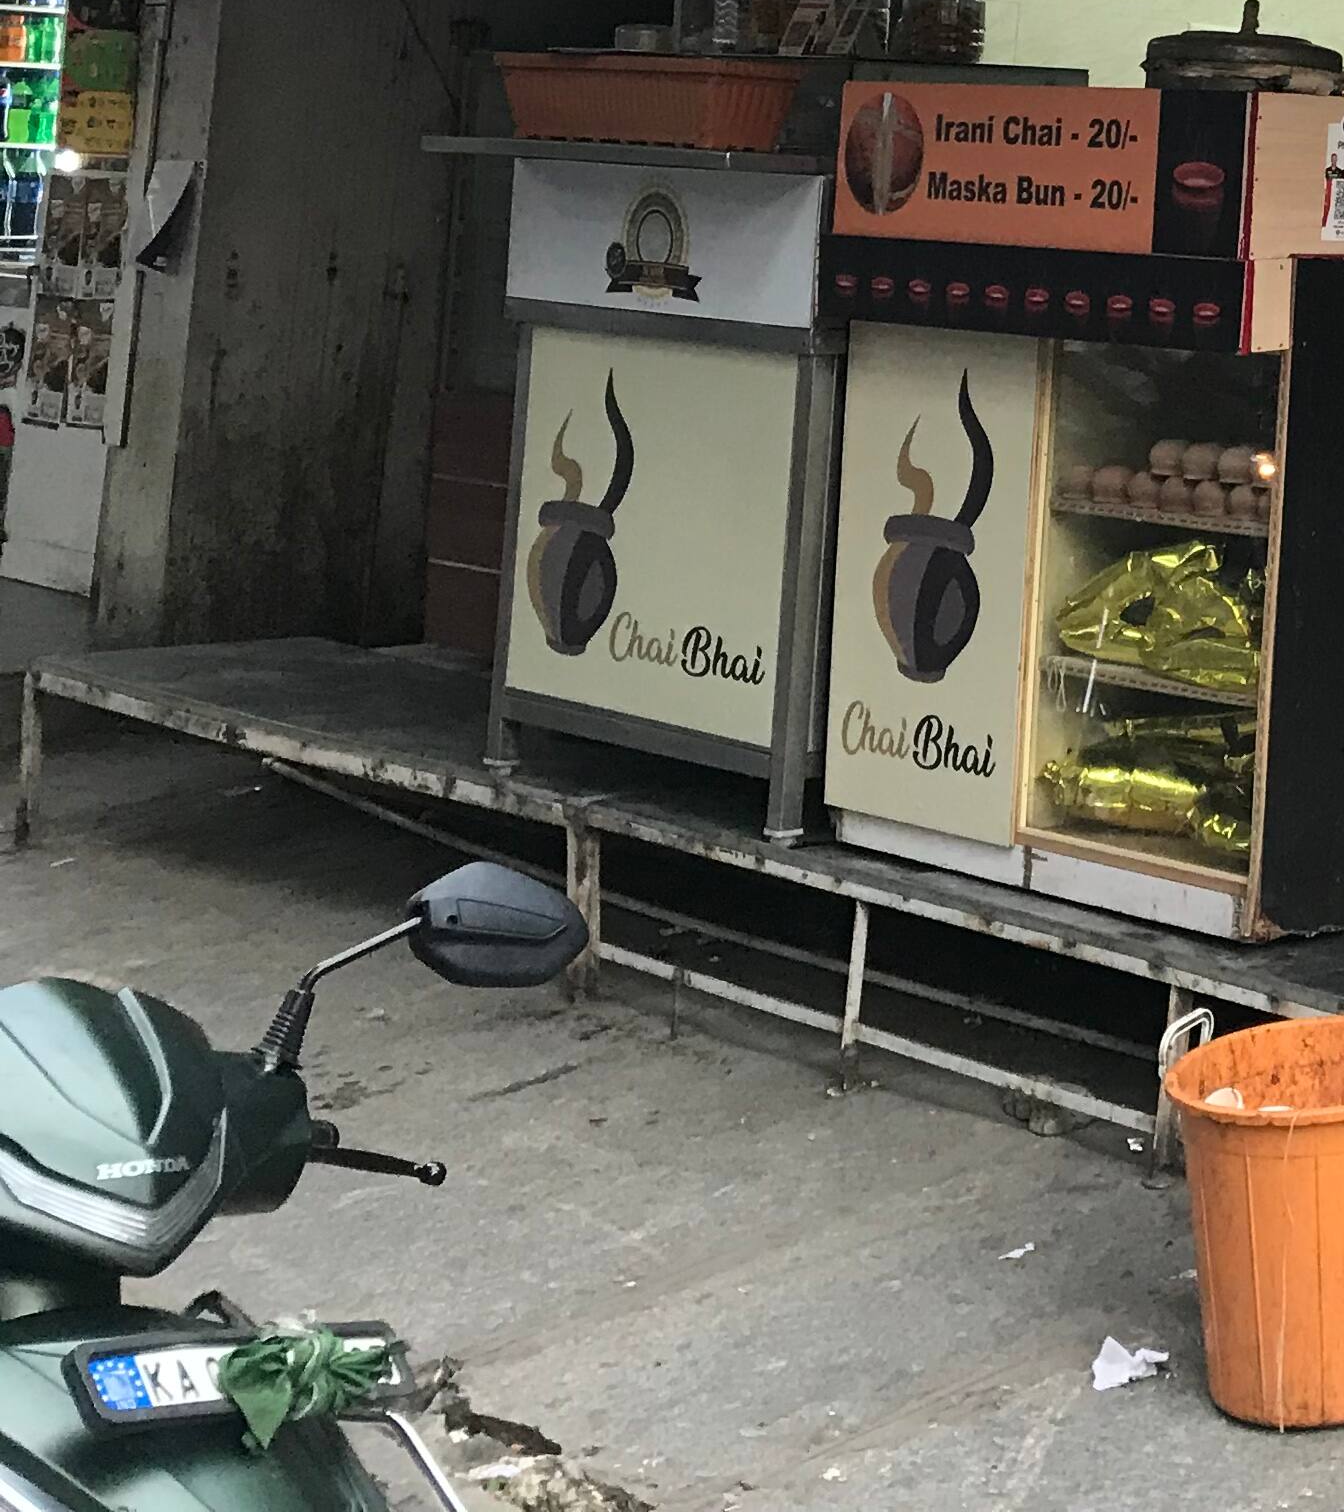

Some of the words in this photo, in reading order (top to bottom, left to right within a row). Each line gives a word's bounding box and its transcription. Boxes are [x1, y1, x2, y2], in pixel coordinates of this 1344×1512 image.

[1002, 115, 1063, 147] Chai
[1087, 118, 1139, 150] 20/-
[926, 171, 1008, 204] Maska
[1016, 175, 1065, 207] Bun
[1089, 179, 1139, 211] 20/-
[608, 610, 679, 669] Chai
[680, 625, 766, 687] Bhai
[841, 699, 911, 759] Chai
[911, 713, 998, 779] Bhai
[96, 1154, 190, 1181] HONDA
